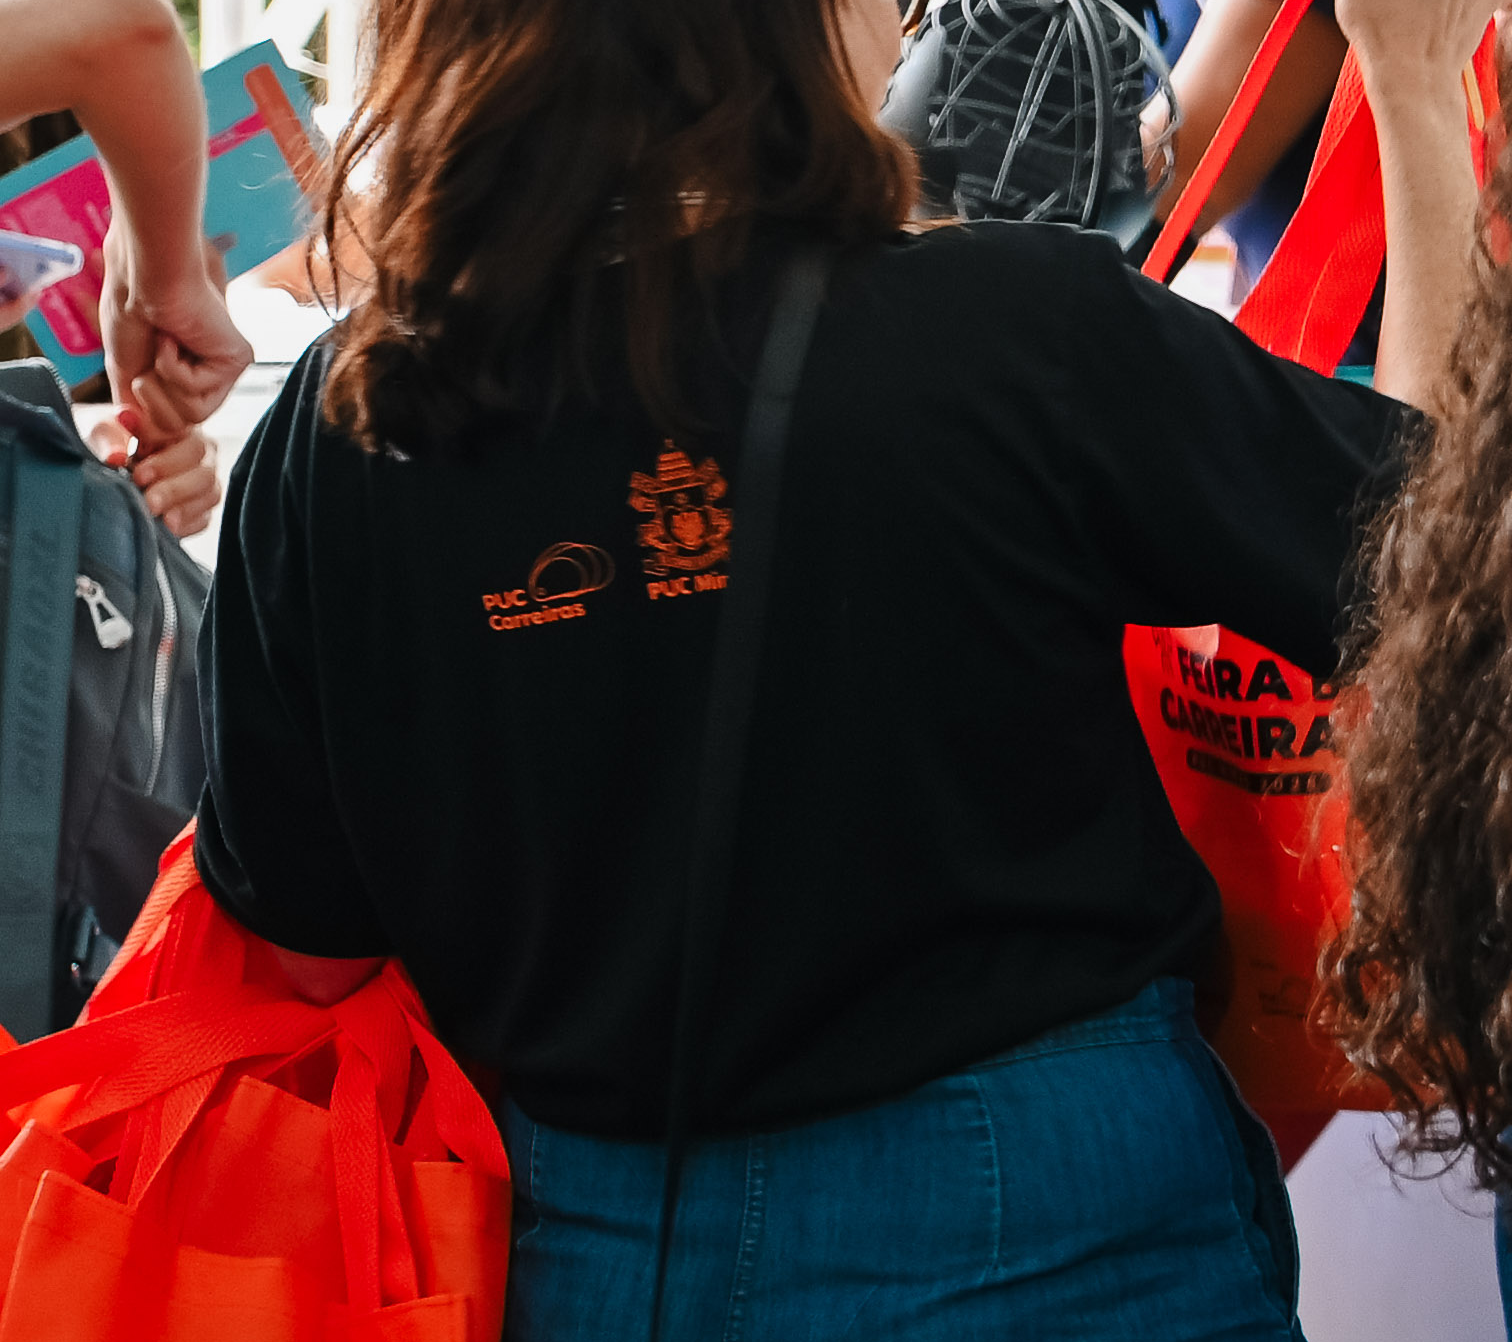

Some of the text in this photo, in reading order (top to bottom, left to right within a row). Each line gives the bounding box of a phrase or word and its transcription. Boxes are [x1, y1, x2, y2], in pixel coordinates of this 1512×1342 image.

[482, 589, 528, 611] PUC
[647, 577, 693, 600] PUC
[489, 603, 586, 631] Carreiras
[1178, 649, 1291, 702] FEIRA
